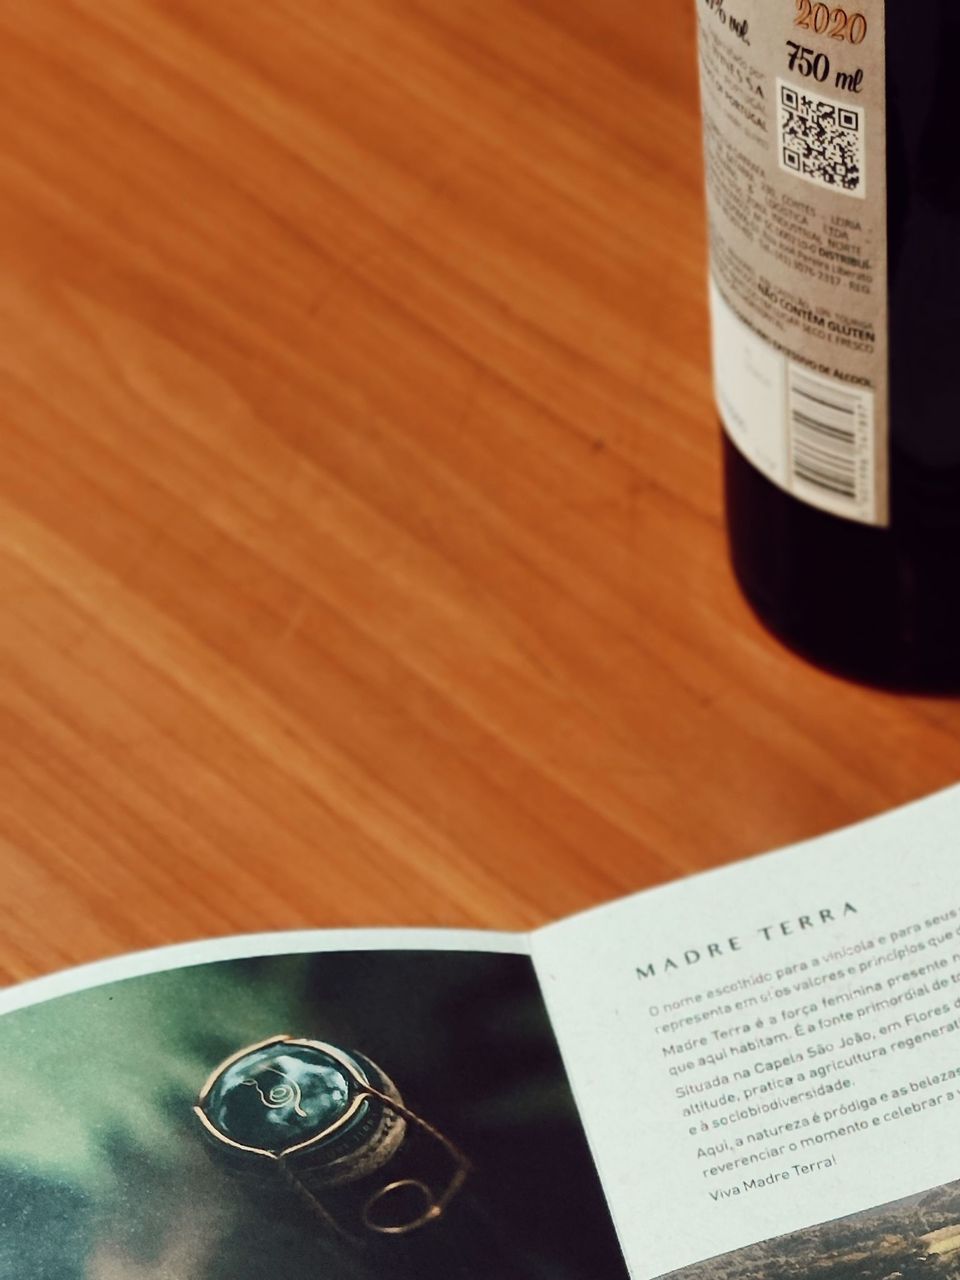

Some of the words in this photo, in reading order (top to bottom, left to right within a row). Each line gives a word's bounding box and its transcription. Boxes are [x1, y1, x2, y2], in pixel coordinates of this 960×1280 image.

[794, 0, 867, 45] 2020
[786, 40, 829, 83] 750
[835, 69, 864, 94] ml
[634, 936, 741, 980] MADRE
[756, 901, 858, 941] TERRA
[701, 1144, 785, 1178] reverenciar
[787, 1141, 798, 1152] o
[799, 1119, 869, 1148] momento
[870, 1116, 881, 1127] e
[882, 1094, 943, 1122] celebrar
[945, 1091, 955, 1101] a
[734, 1137, 744, 1147] a
[745, 1117, 810, 1143] natureza
[811, 1111, 821, 1124] é
[822, 1096, 878, 1122] pródiga
[878, 1092, 889, 1102] e
[890, 1086, 909, 1099] as
[708, 1185, 741, 1201] Viva
[741, 1170, 790, 1192] Madre
